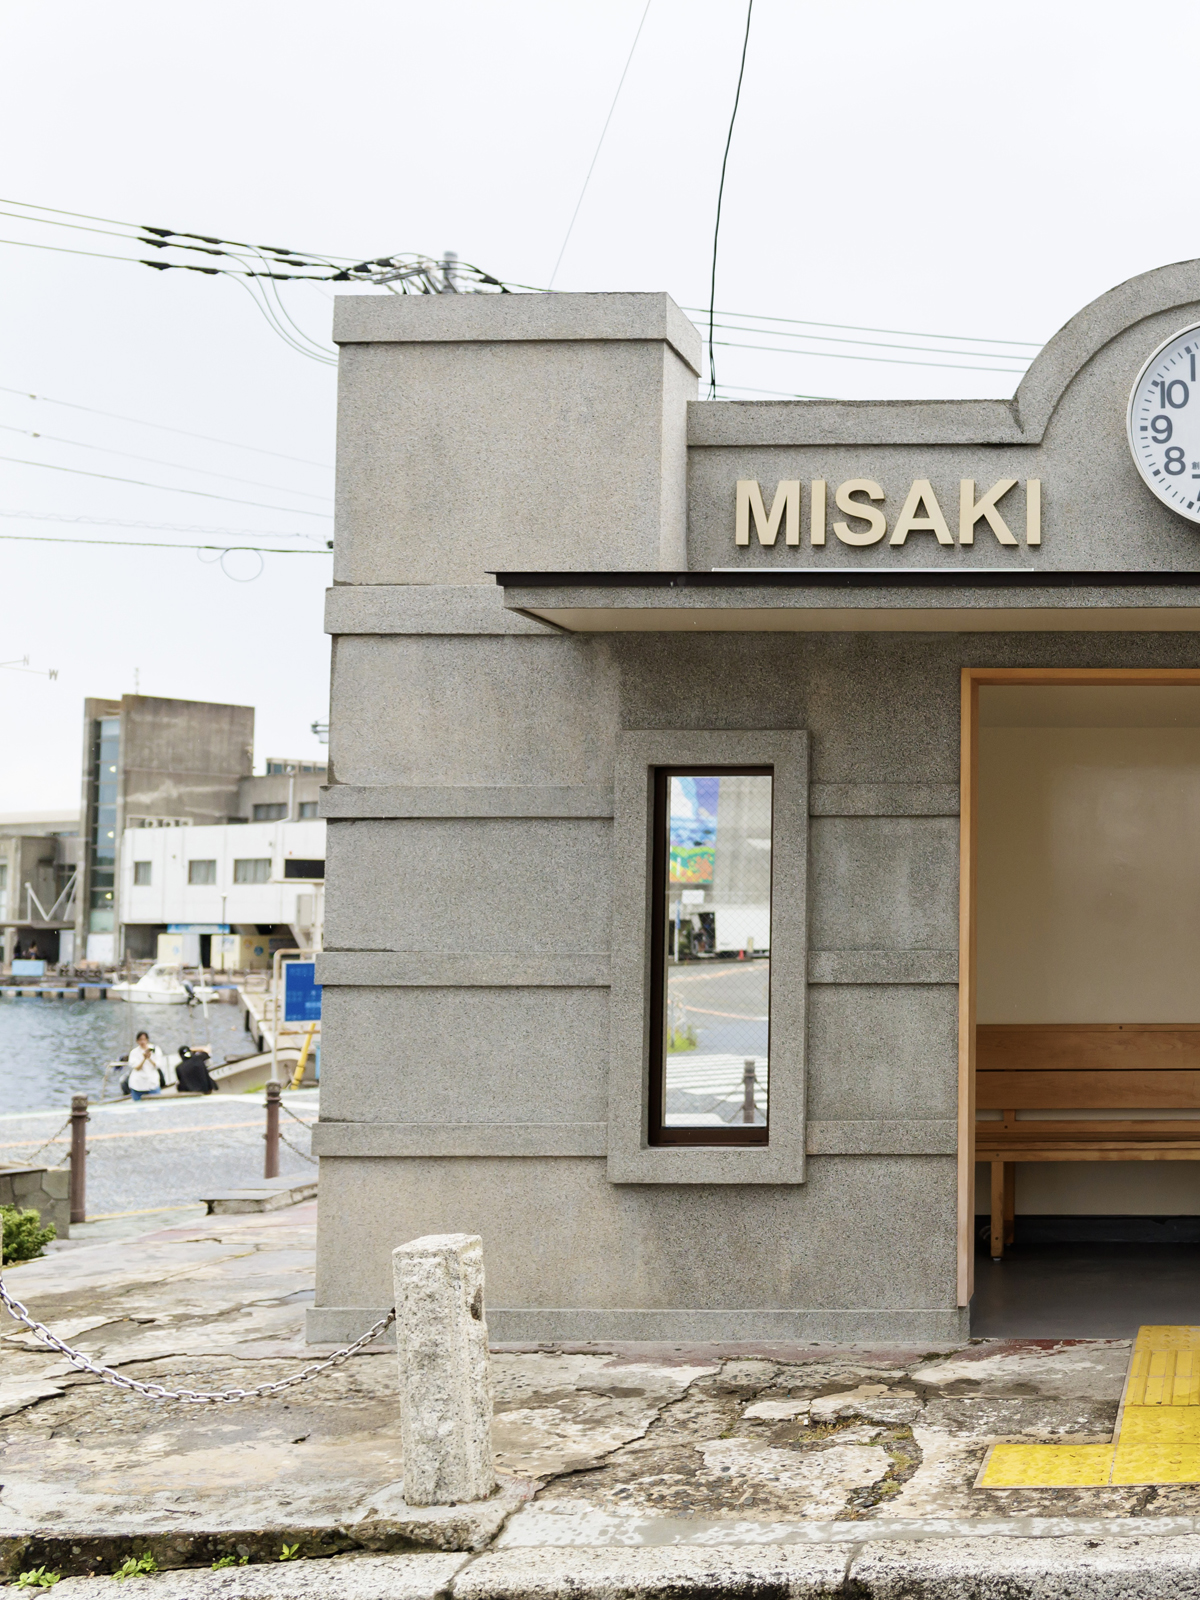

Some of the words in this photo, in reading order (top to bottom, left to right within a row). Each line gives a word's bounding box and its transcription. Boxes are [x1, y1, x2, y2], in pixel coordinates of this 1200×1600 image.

[1160, 379, 1190, 409] 10
[1150, 414, 1173, 444] 9
[1163, 446, 1186, 476] 8
[735, 478, 1042, 546] MISAKI
